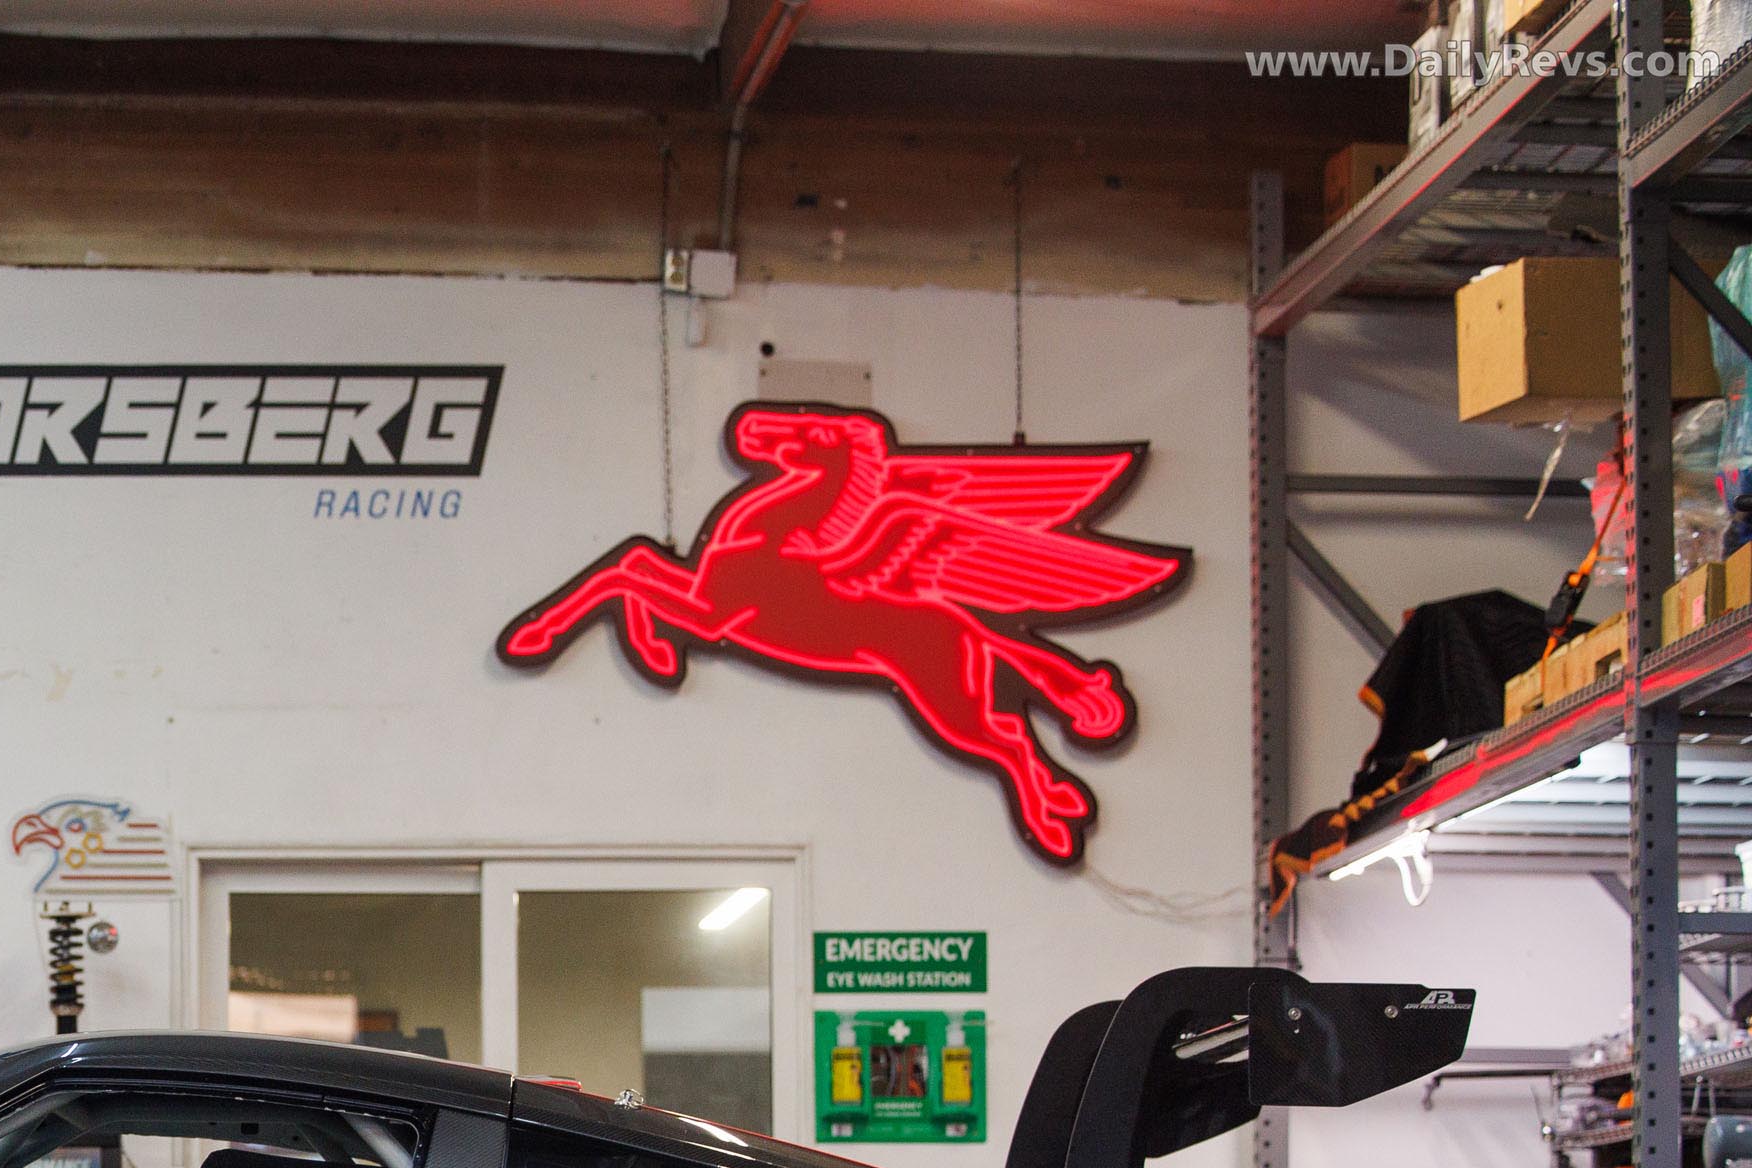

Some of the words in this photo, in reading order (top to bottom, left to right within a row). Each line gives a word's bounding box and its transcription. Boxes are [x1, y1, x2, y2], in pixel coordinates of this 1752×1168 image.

[313, 489, 464, 519] RACING
[825, 937, 974, 963] EMERGENCY
[826, 971, 855, 988] EYE
[857, 971, 904, 988] WASH
[906, 971, 972, 988] STATION
